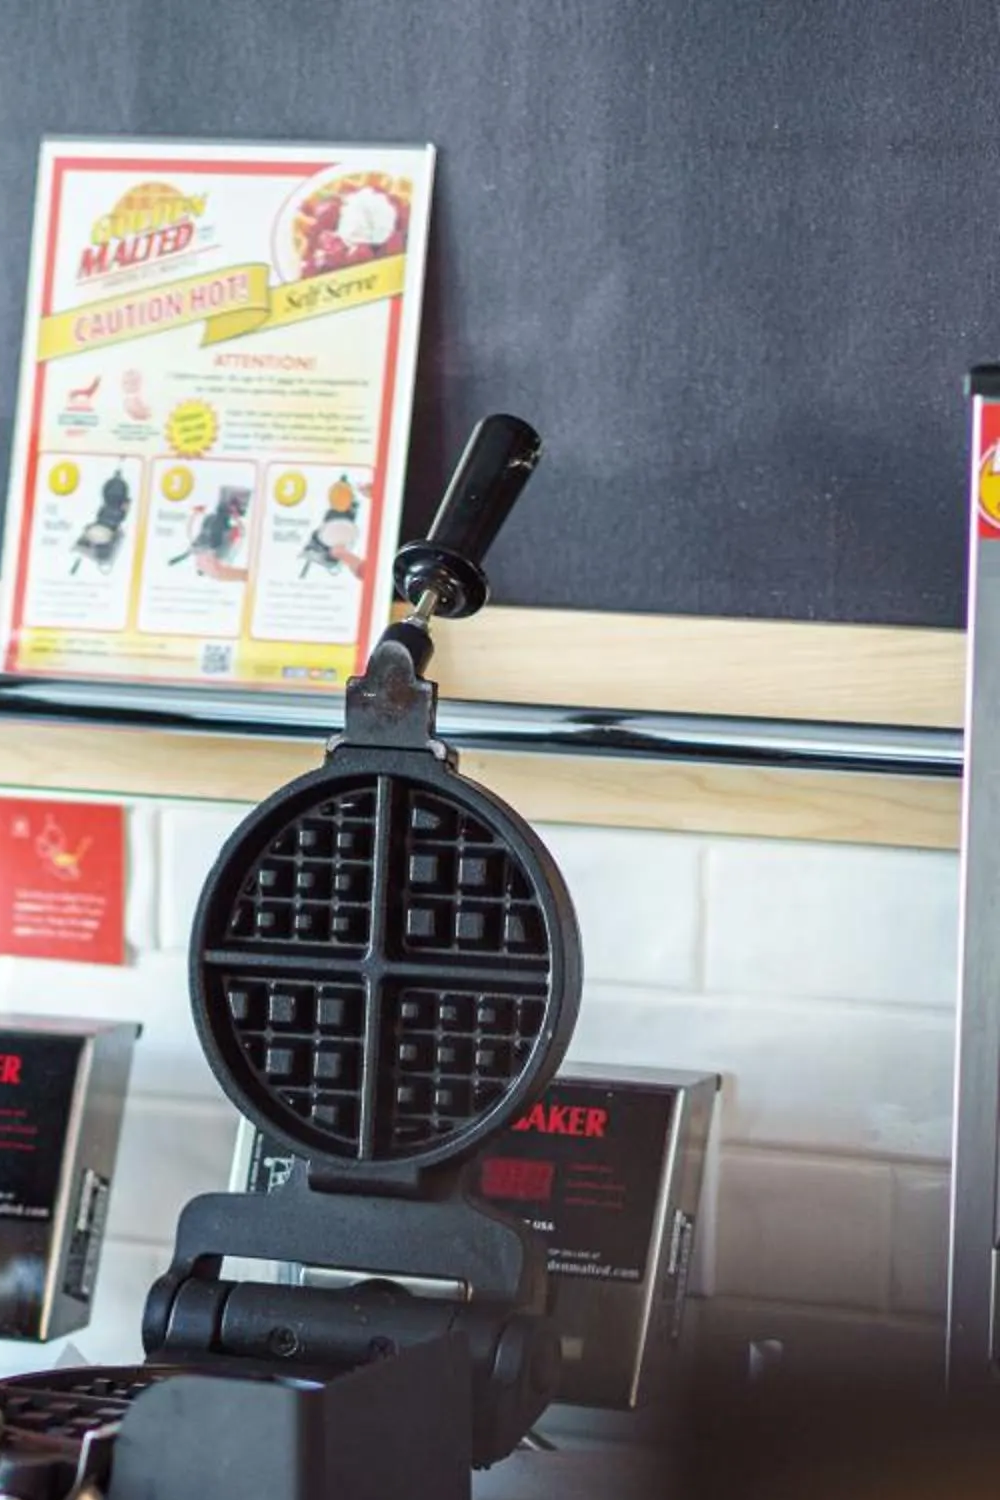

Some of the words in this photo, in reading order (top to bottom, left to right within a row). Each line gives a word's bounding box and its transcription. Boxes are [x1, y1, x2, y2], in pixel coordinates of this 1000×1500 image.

[76, 222, 194, 279] MALTED
[74, 290, 184, 343] CAUTION
[190, 274, 249, 312] HOT!
[323, 274, 378, 302] Serve
[532, 1220, 555, 1231] USA
